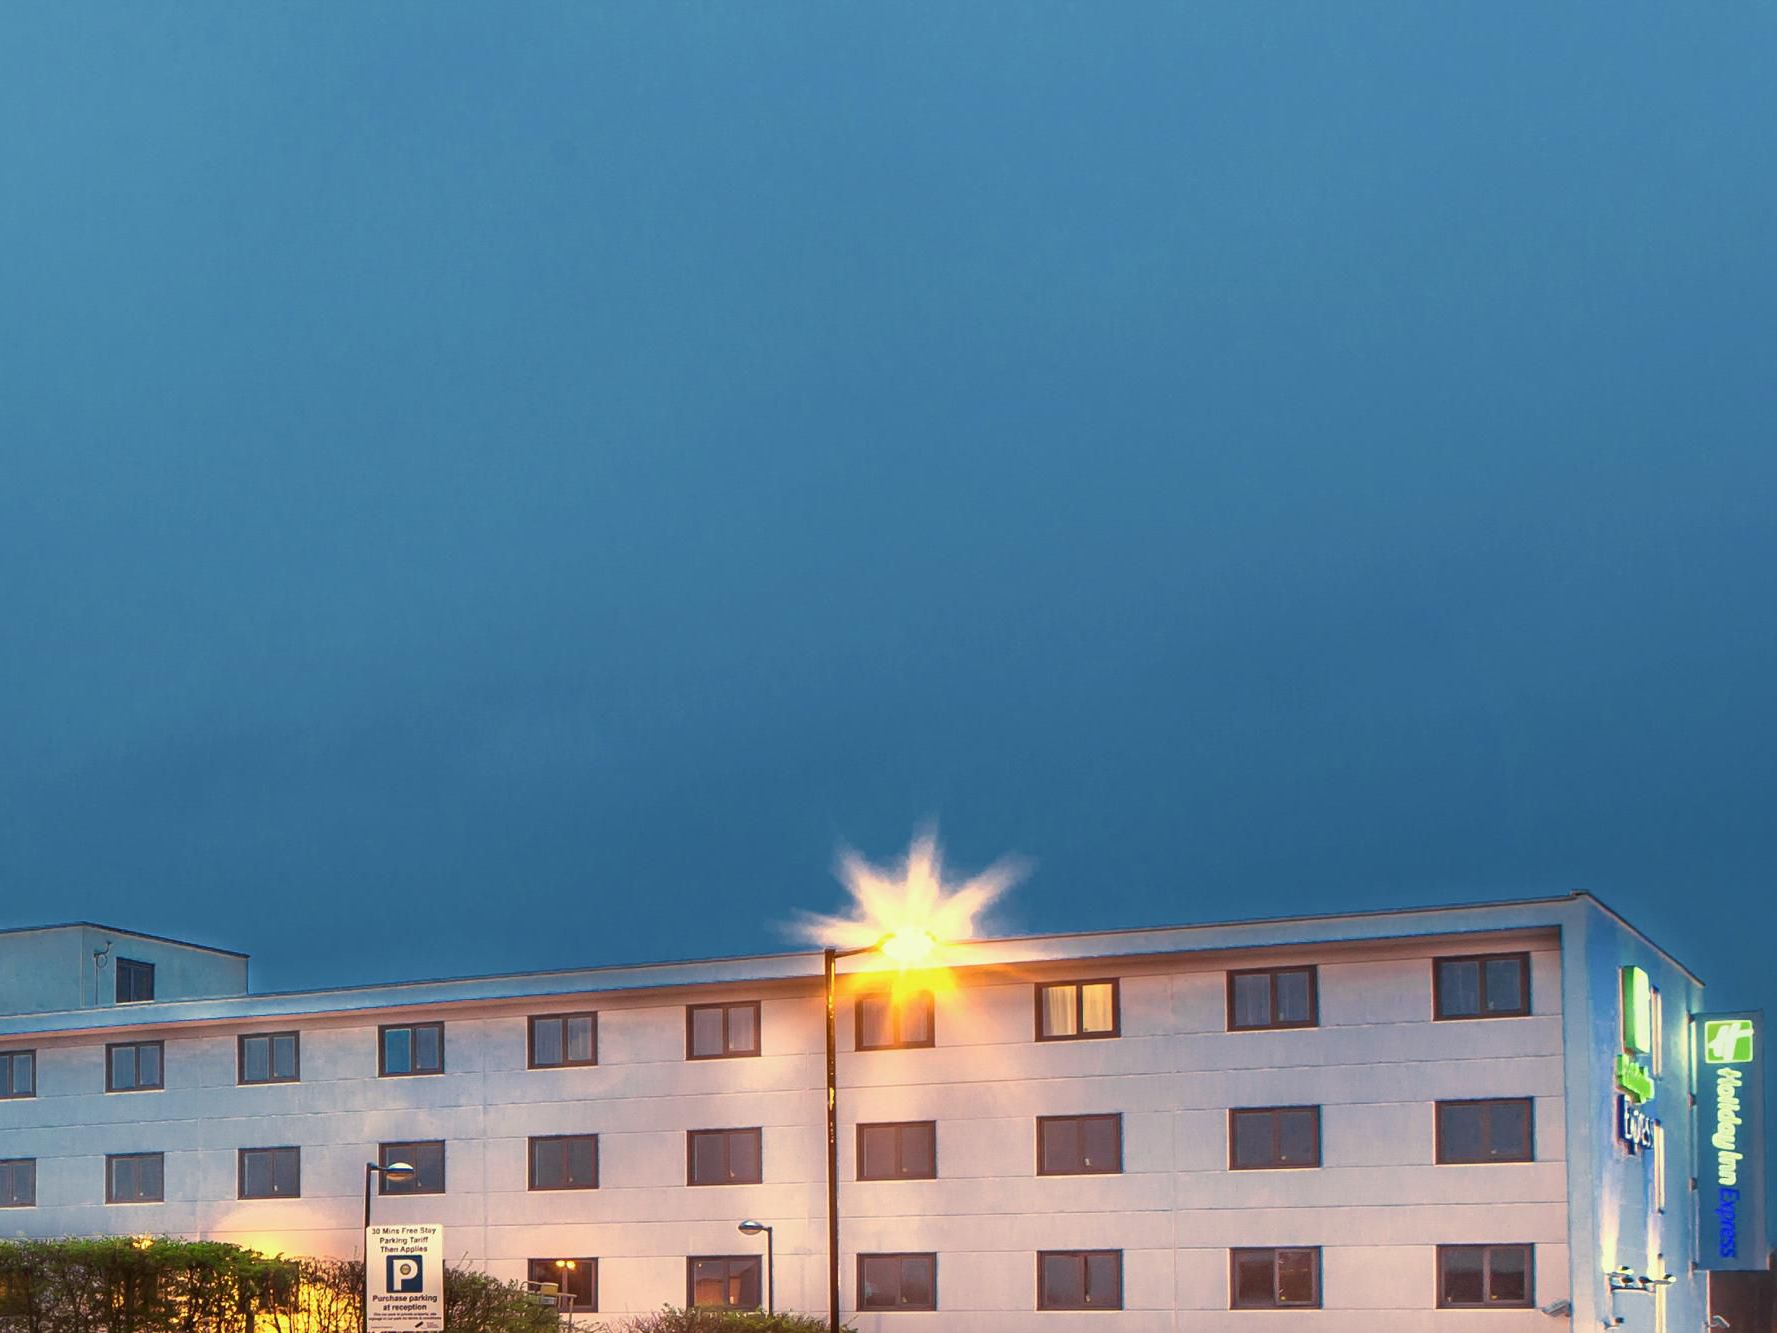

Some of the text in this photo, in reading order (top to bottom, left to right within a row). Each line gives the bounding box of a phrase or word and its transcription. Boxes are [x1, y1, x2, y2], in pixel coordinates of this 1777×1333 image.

[1711, 1066, 1744, 1259] Holiday Inn Express
[382, 1227, 400, 1235] Mins
[420, 1226, 437, 1235] Stay
[379, 1236, 429, 1245] Parking Tariff
[400, 1246, 428, 1254] Applies
[393, 1259, 419, 1292] P
[408, 1294, 438, 1303] parking
[392, 1303, 427, 1312] reception
